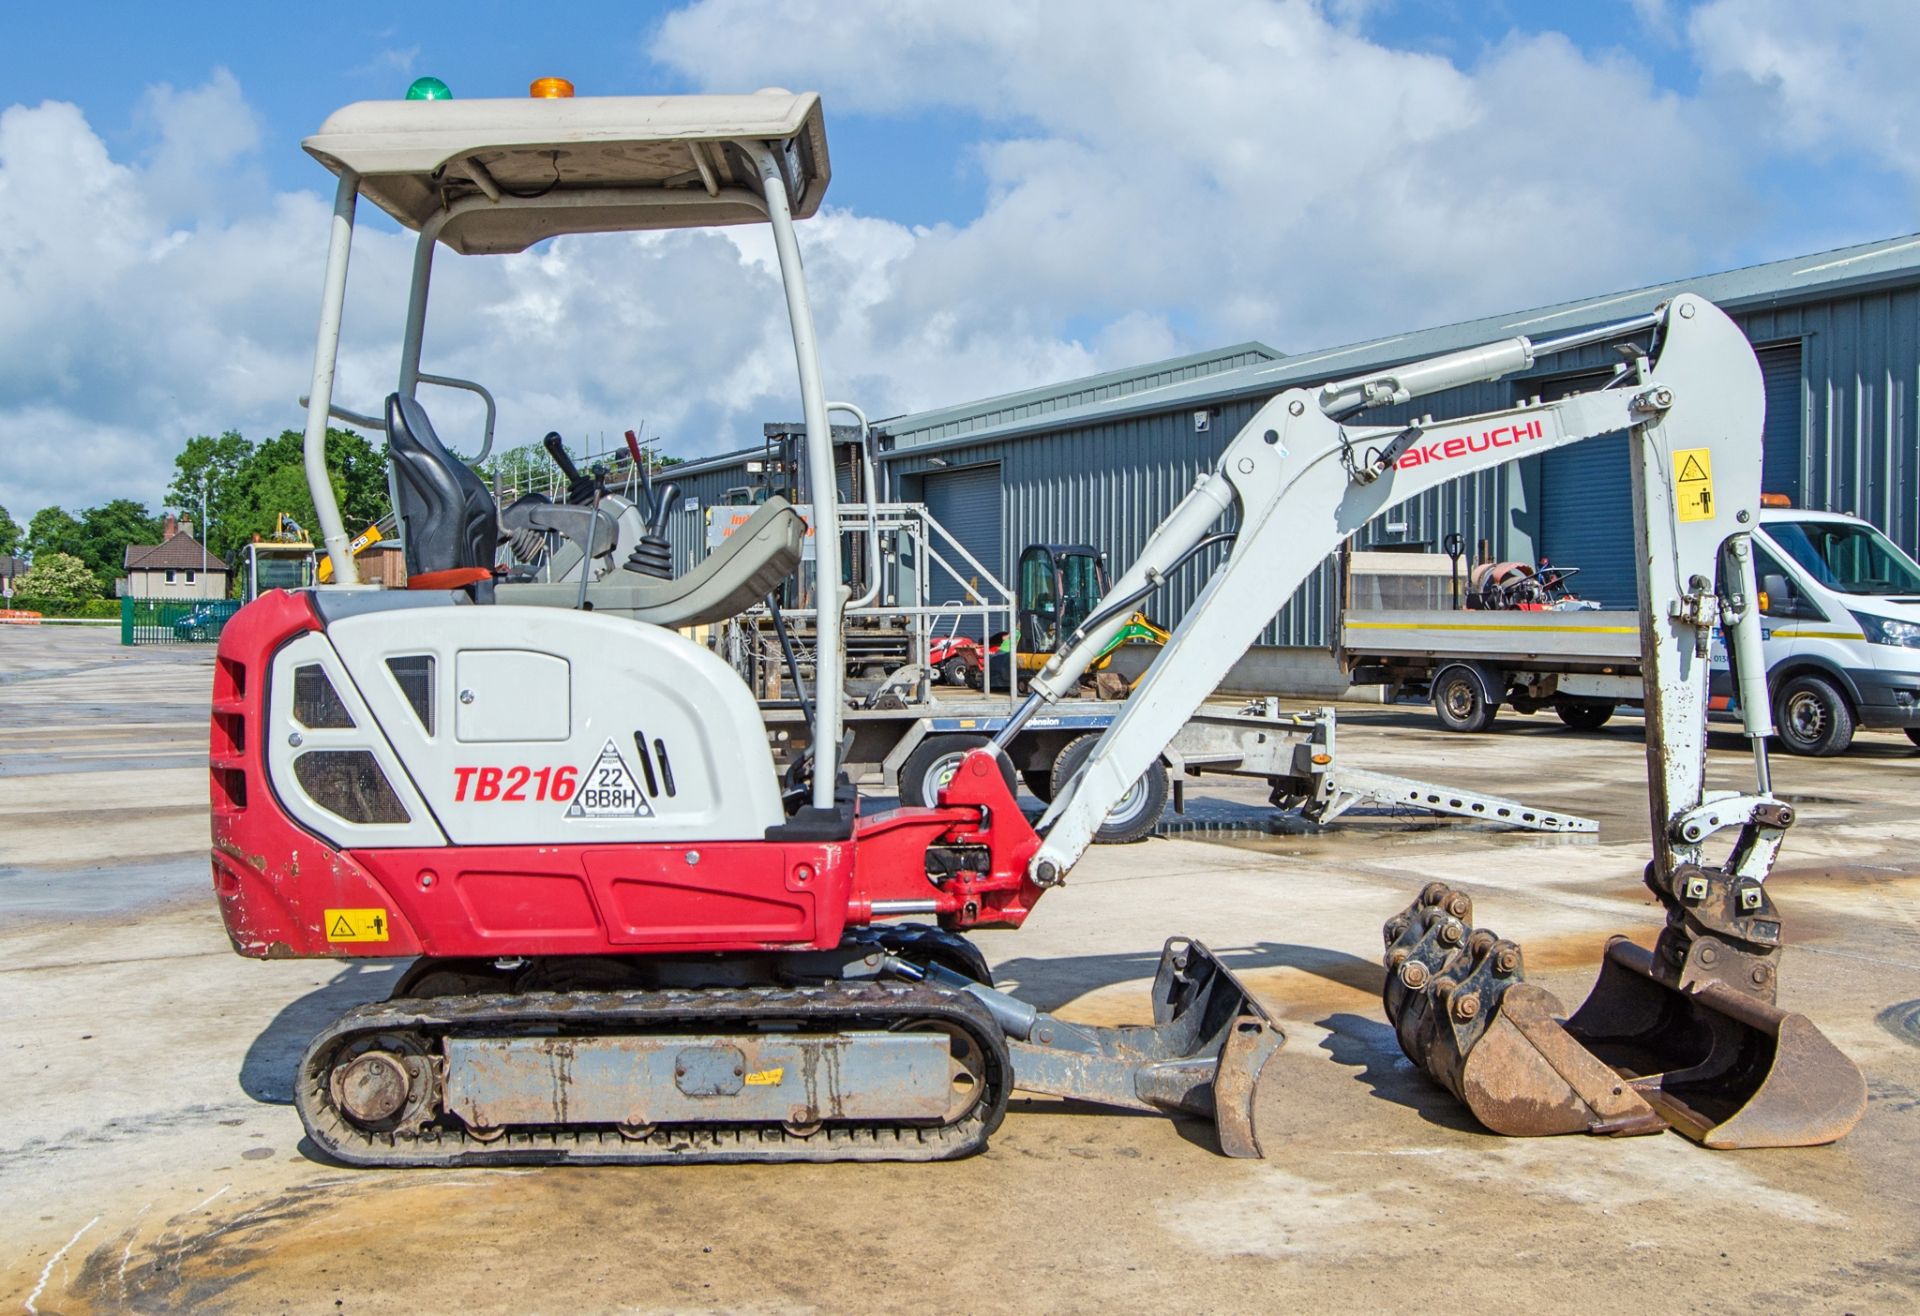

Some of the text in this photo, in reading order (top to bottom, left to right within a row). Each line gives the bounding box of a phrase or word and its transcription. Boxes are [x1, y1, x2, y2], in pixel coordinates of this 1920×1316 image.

[1393, 420, 1543, 471] AKEUCHI
[454, 765, 578, 802] TB216
[599, 768, 623, 788] 22
[585, 789, 635, 809] BB8H
